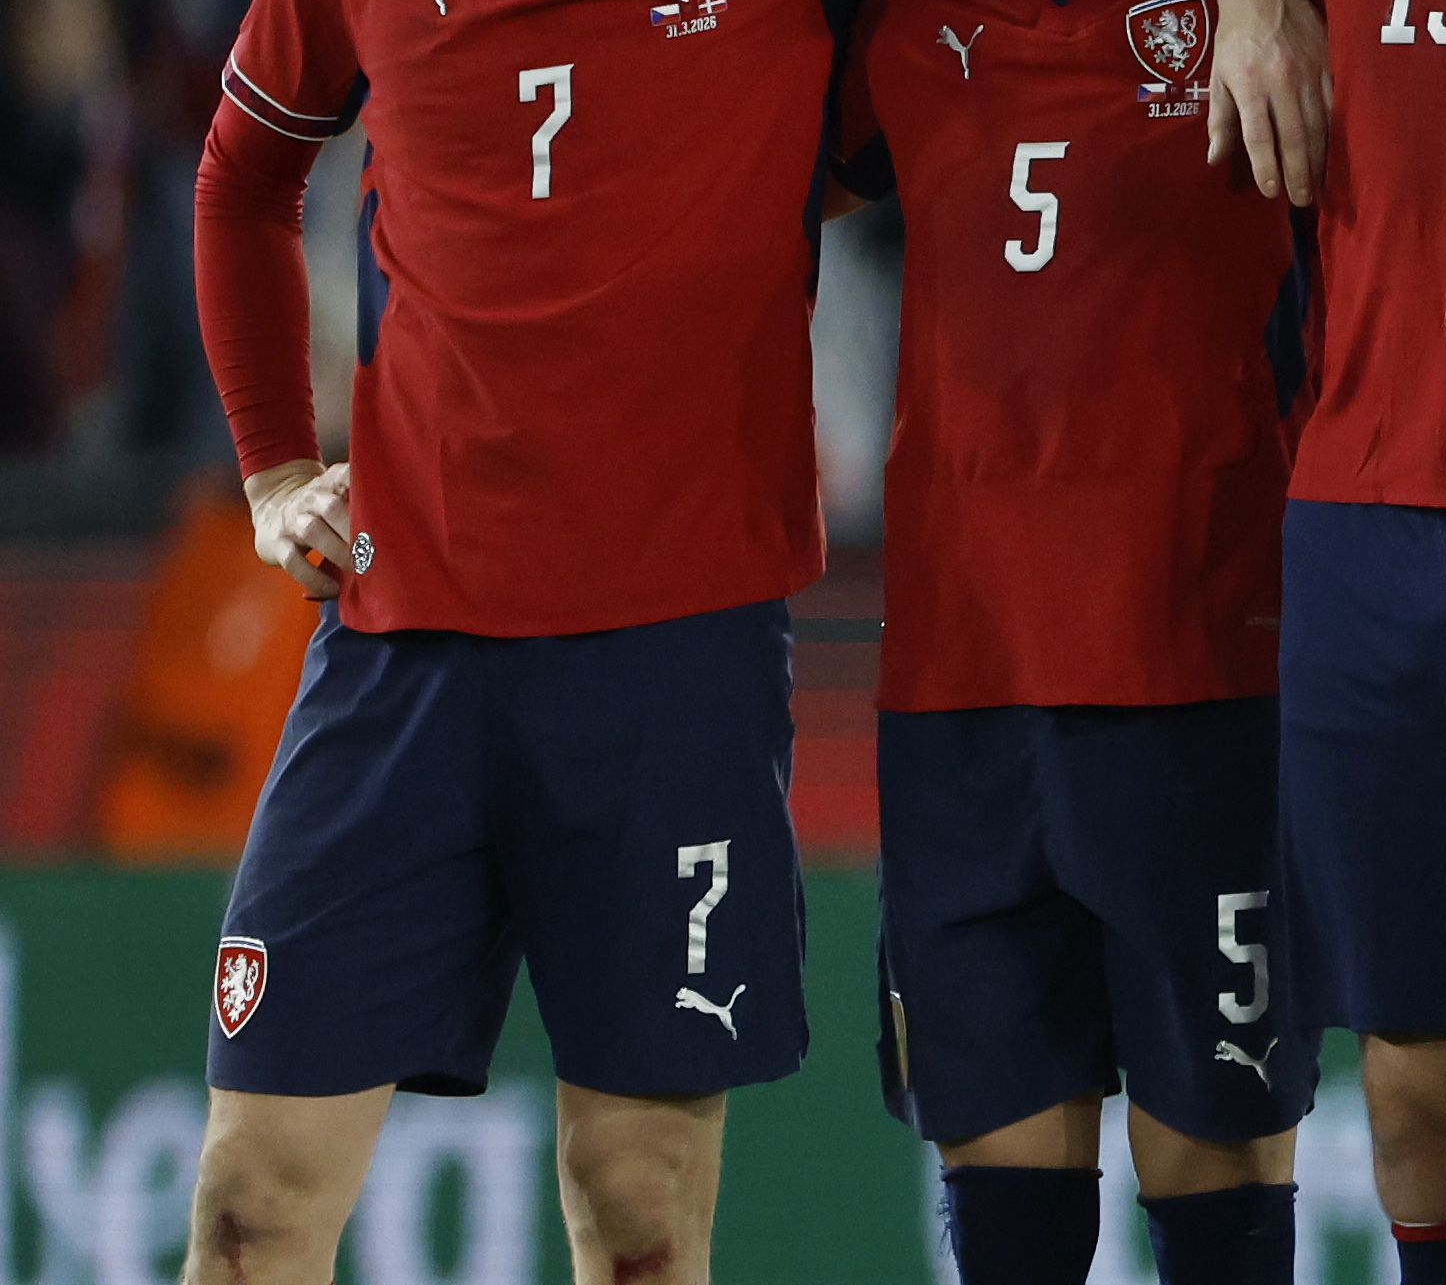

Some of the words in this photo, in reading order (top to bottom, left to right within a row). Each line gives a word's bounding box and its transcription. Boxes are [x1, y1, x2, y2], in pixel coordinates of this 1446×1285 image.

[666, 15, 717, 38] 31.3.2026
[519, 64, 574, 199] 7
[1005, 142, 1070, 271] 5
[678, 840, 731, 973] 7
[1217, 891, 1270, 1024] 5
